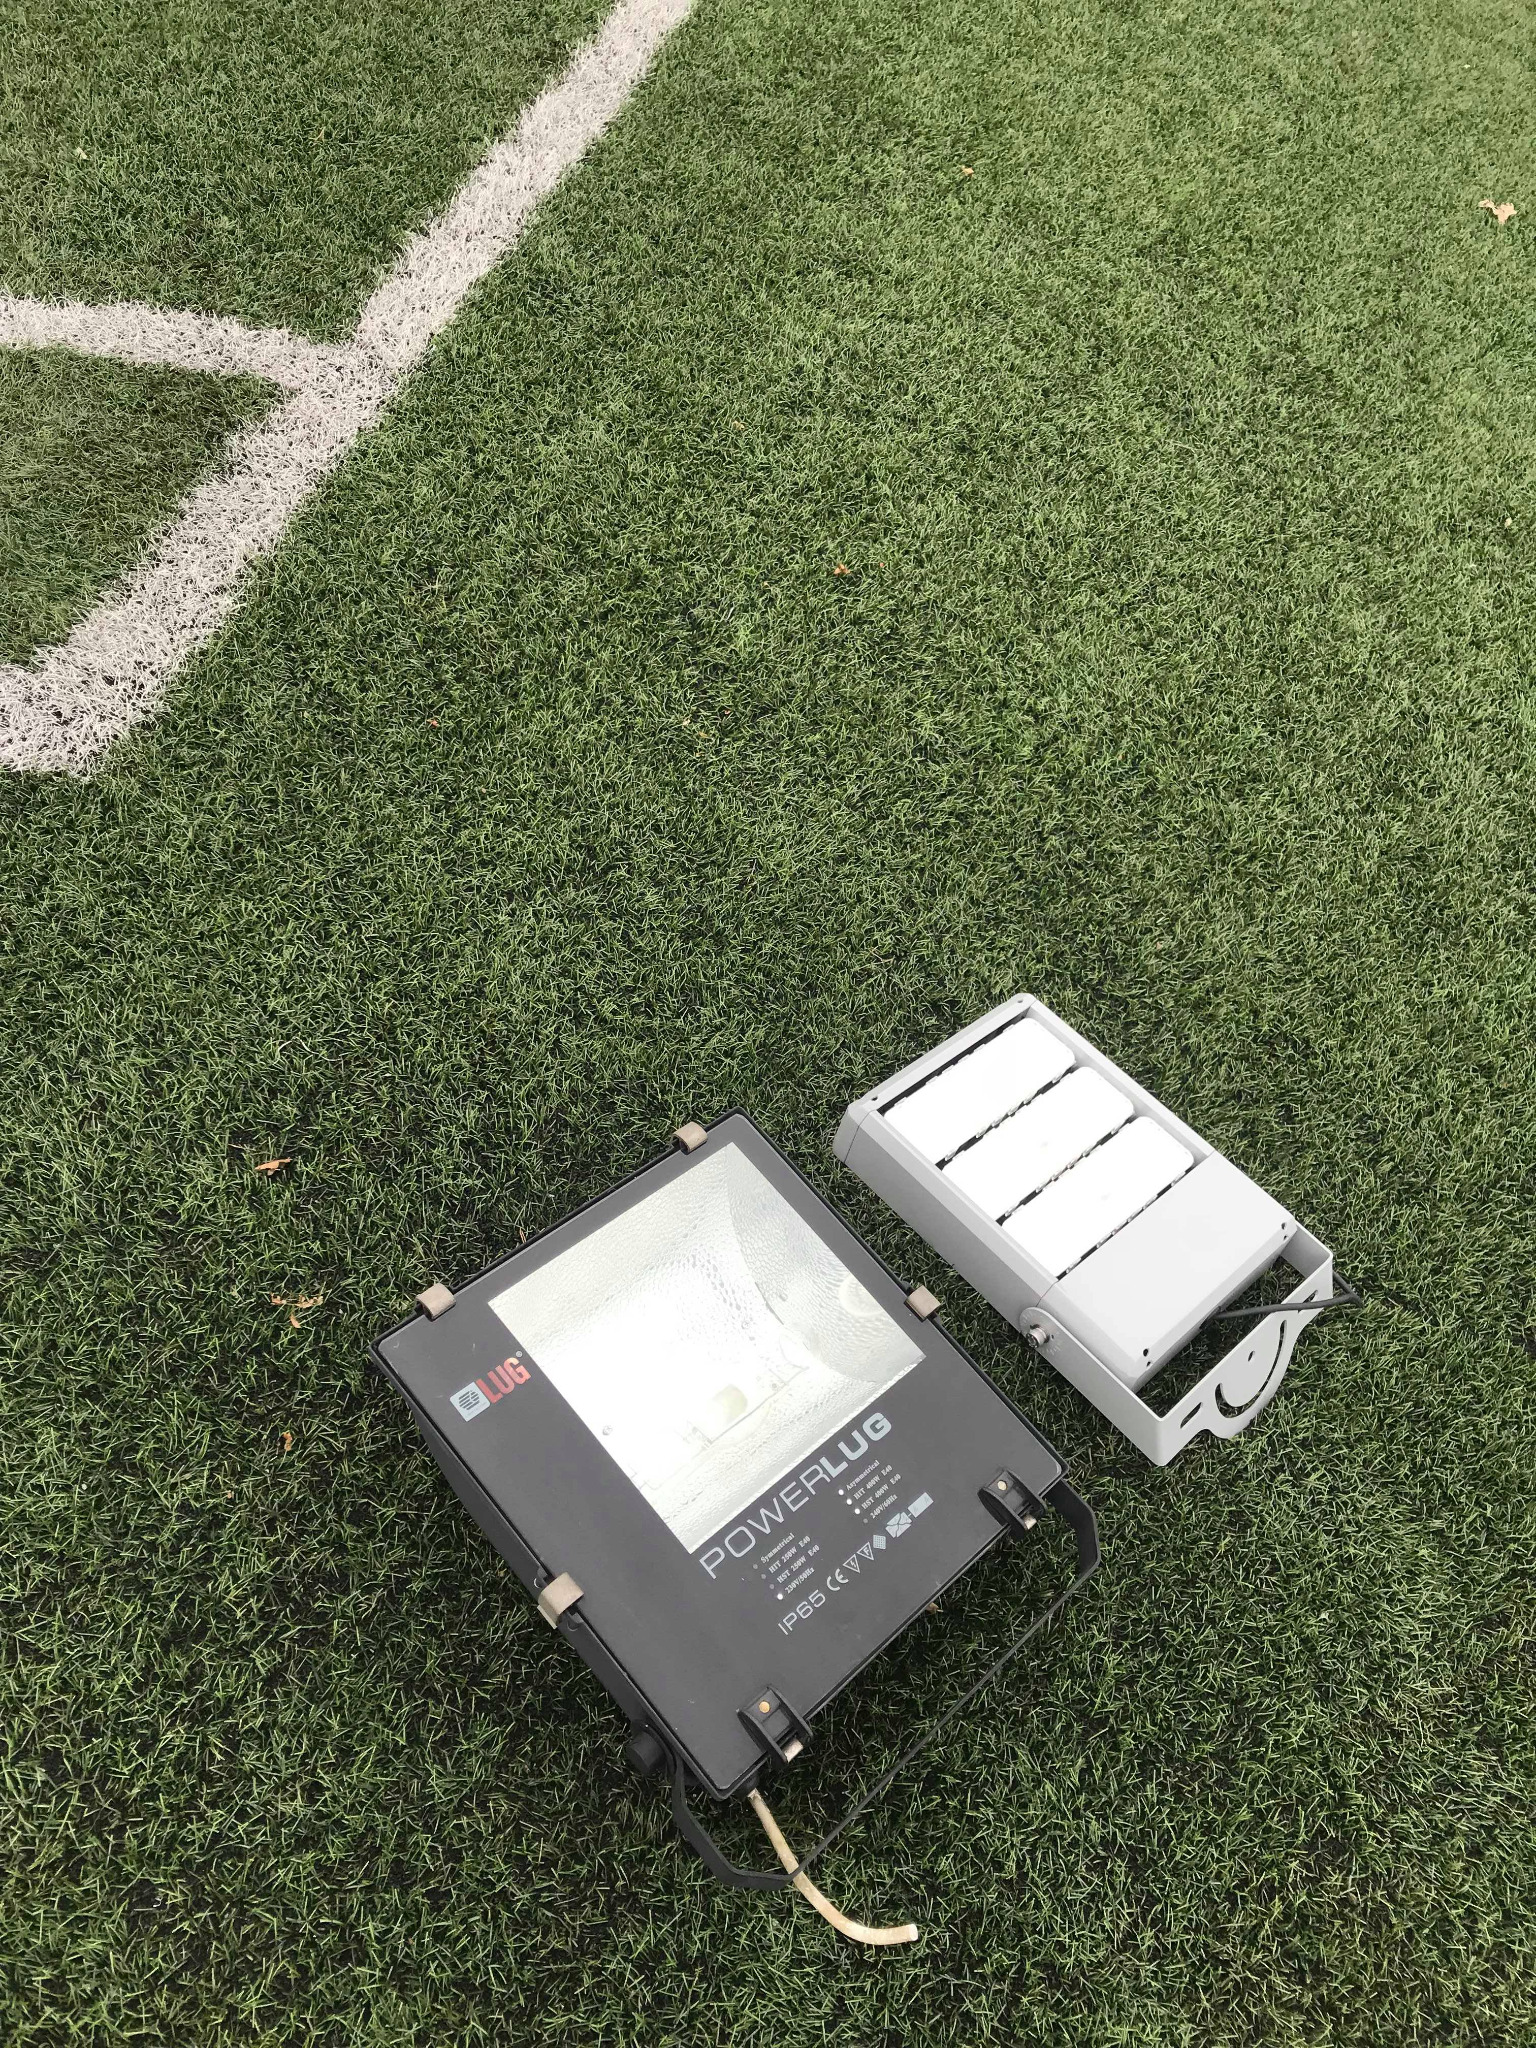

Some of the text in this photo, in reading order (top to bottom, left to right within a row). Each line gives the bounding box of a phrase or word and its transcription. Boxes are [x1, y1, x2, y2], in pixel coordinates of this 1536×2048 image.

[846, 1460, 880, 1490] Asymmetrical
[866, 1475, 880, 1489] 400W
[881, 1465, 892, 1476] E40
[699, 1412, 893, 1580] POWERLUG
[861, 1474, 901, 1510] HST 400W E40
[761, 1532, 795, 1564] Symmetrical
[781, 1546, 798, 1563] 250W
[799, 1536, 811, 1547] E40
[776, 1545, 820, 1584] HST 250W E40
[784, 1567, 815, 1594] 230V/50Hz
[777, 1589, 826, 1636] IP65
